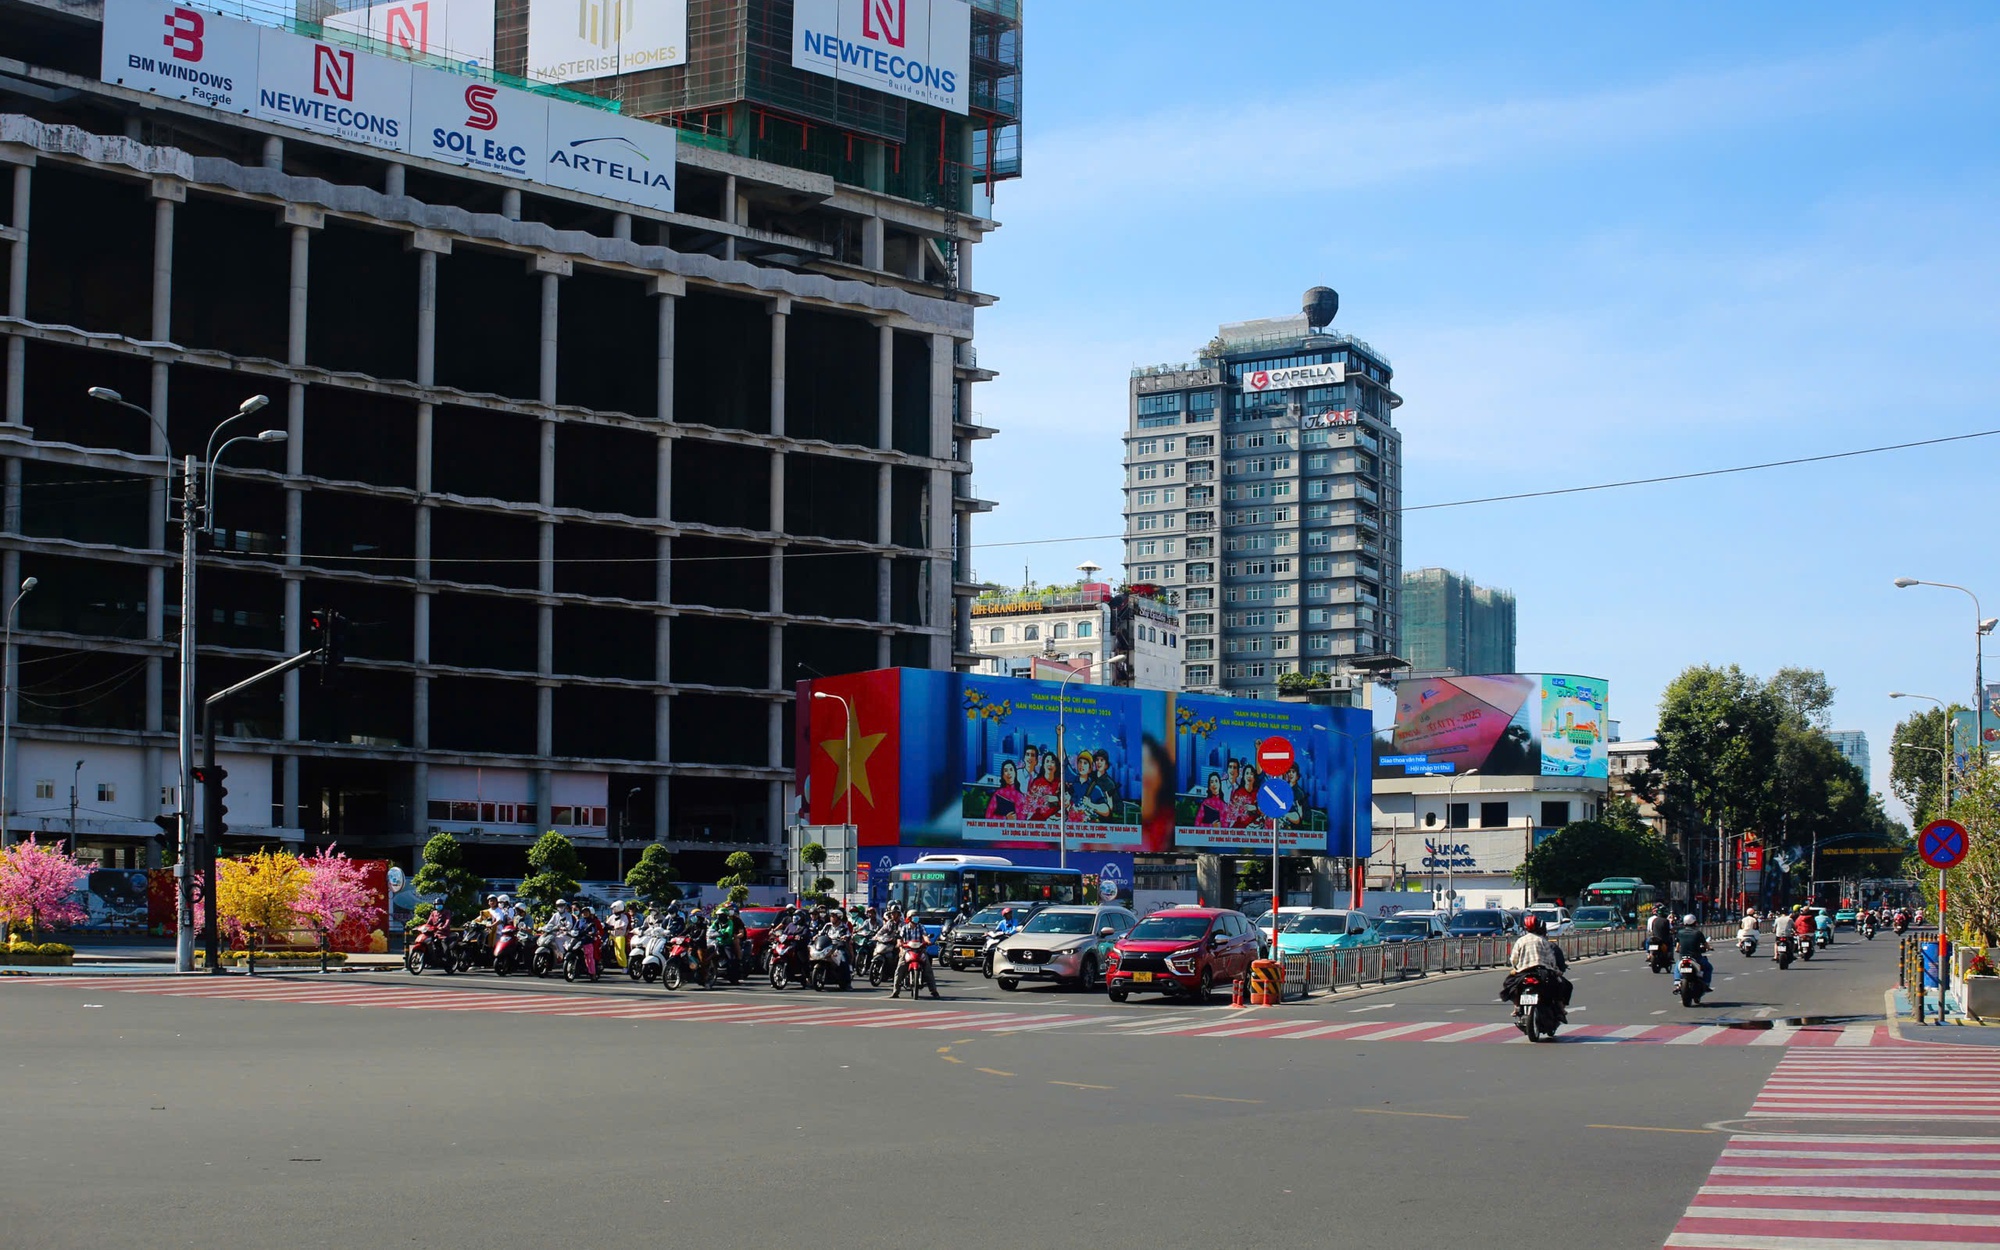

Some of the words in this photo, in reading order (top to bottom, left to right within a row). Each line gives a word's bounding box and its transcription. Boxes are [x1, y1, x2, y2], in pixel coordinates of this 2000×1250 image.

[128, 54, 154, 72] BM
[158, 61, 233, 91] WINDOWS
[536, 55, 618, 79] MASTERISE
[624, 46, 676, 67] HOMES
[805, 29, 956, 93] NEWTECONS
[192, 86, 232, 105] Façade
[889, 79, 912, 93] Build
[916, 88, 926, 97] on
[928, 91, 955, 105] trust
[260, 89, 399, 138] NEWTECONS
[337, 126, 358, 139] Build
[374, 136, 398, 147] trust
[433, 128, 477, 156] SOL
[484, 139, 526, 166] E&C
[475, 159, 492, 167] Success
[501, 164, 526, 175] Achievement
[549, 150, 672, 191] ARTELIA
[1271, 377, 1337, 388] HOLDINGS
[1272, 367, 1335, 382] CAPELLA
[1326, 408, 1353, 422] ONE
[988, 602, 1018, 614] GRAND
[1018, 600, 1043, 612] HOTEL
